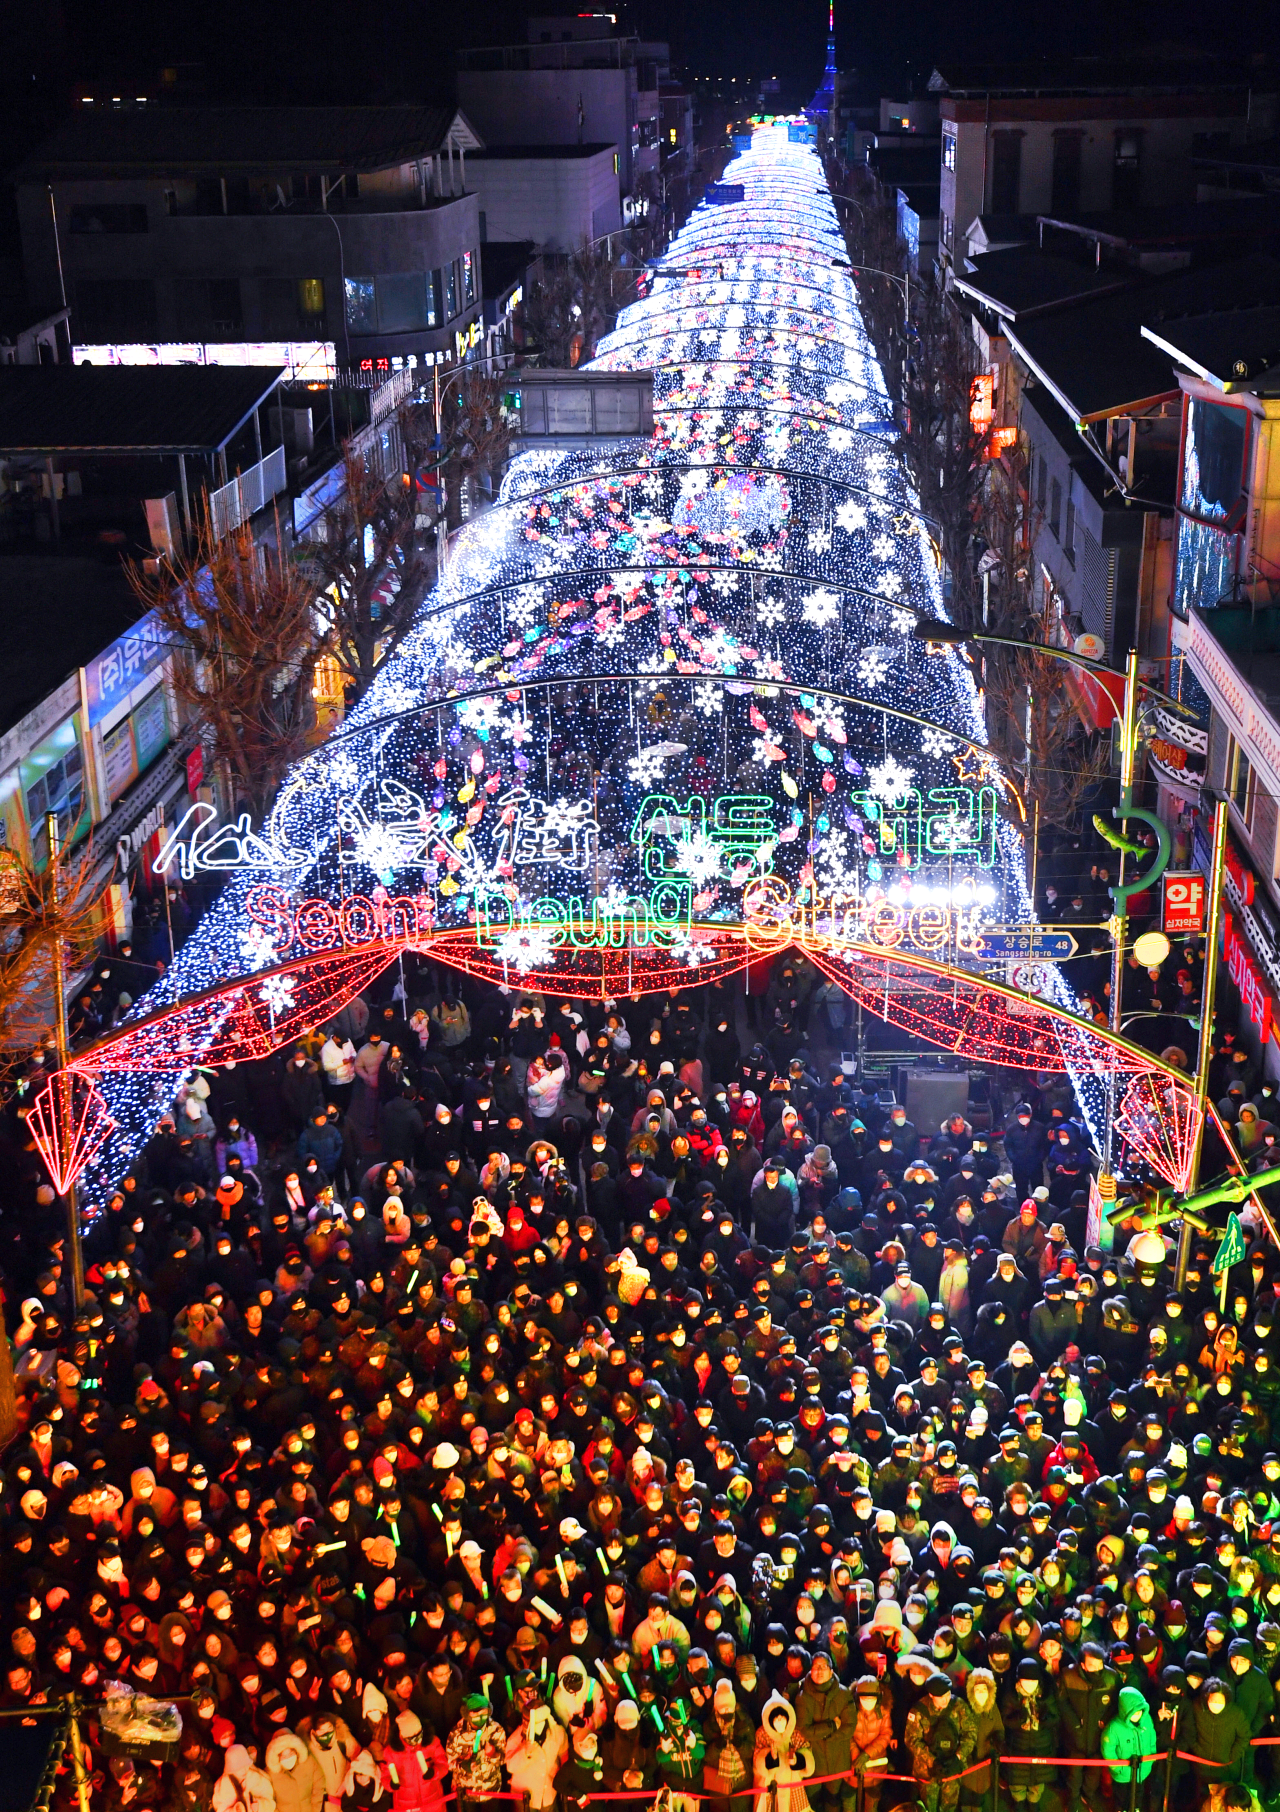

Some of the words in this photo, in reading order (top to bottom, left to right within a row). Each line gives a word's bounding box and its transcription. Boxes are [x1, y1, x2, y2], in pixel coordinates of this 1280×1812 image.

[850, 787, 997, 871] 거리
[1167, 883, 1202, 915] 약
[246, 885, 421, 952] Seon
[473, 881, 692, 949] Deung
[744, 875, 984, 952] Street
[1166, 917, 1201, 929] 십자약국
[1003, 936, 1044, 949] 상승로
[1055, 941, 1069, 950] 48
[995, 949, 1052, 958] Sangseung-ro
[1019, 973, 1040, 987] 30
